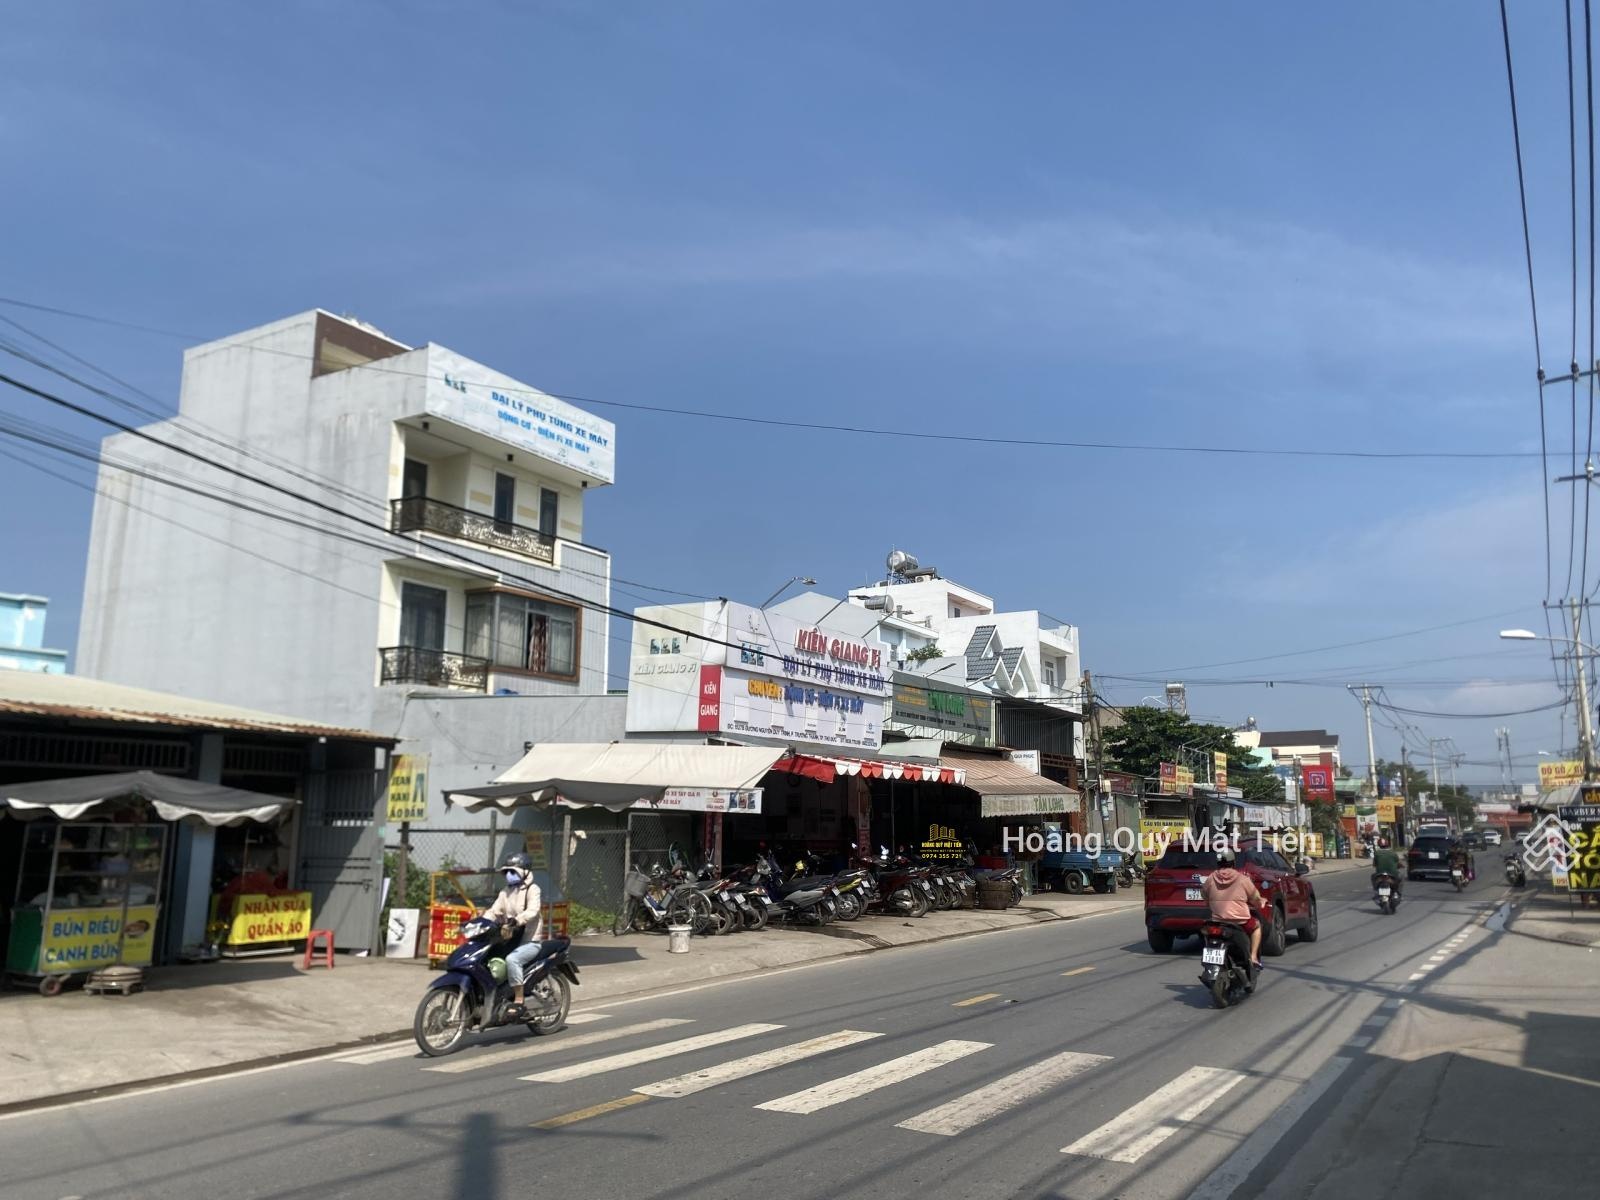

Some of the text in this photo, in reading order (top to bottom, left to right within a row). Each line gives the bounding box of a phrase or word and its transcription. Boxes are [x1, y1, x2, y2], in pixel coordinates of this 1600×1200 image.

[565, 438, 573, 447] XE
[575, 426, 587, 438] XE
[589, 432, 608, 447] MÁY
[796, 627, 827, 655] KIÊN
[830, 638, 869, 666] GIANG
[704, 681, 717, 694] KIÊN
[856, 671, 867, 688] XE
[700, 704, 718, 716] GIANG
[46, 945, 87, 963] CANH
